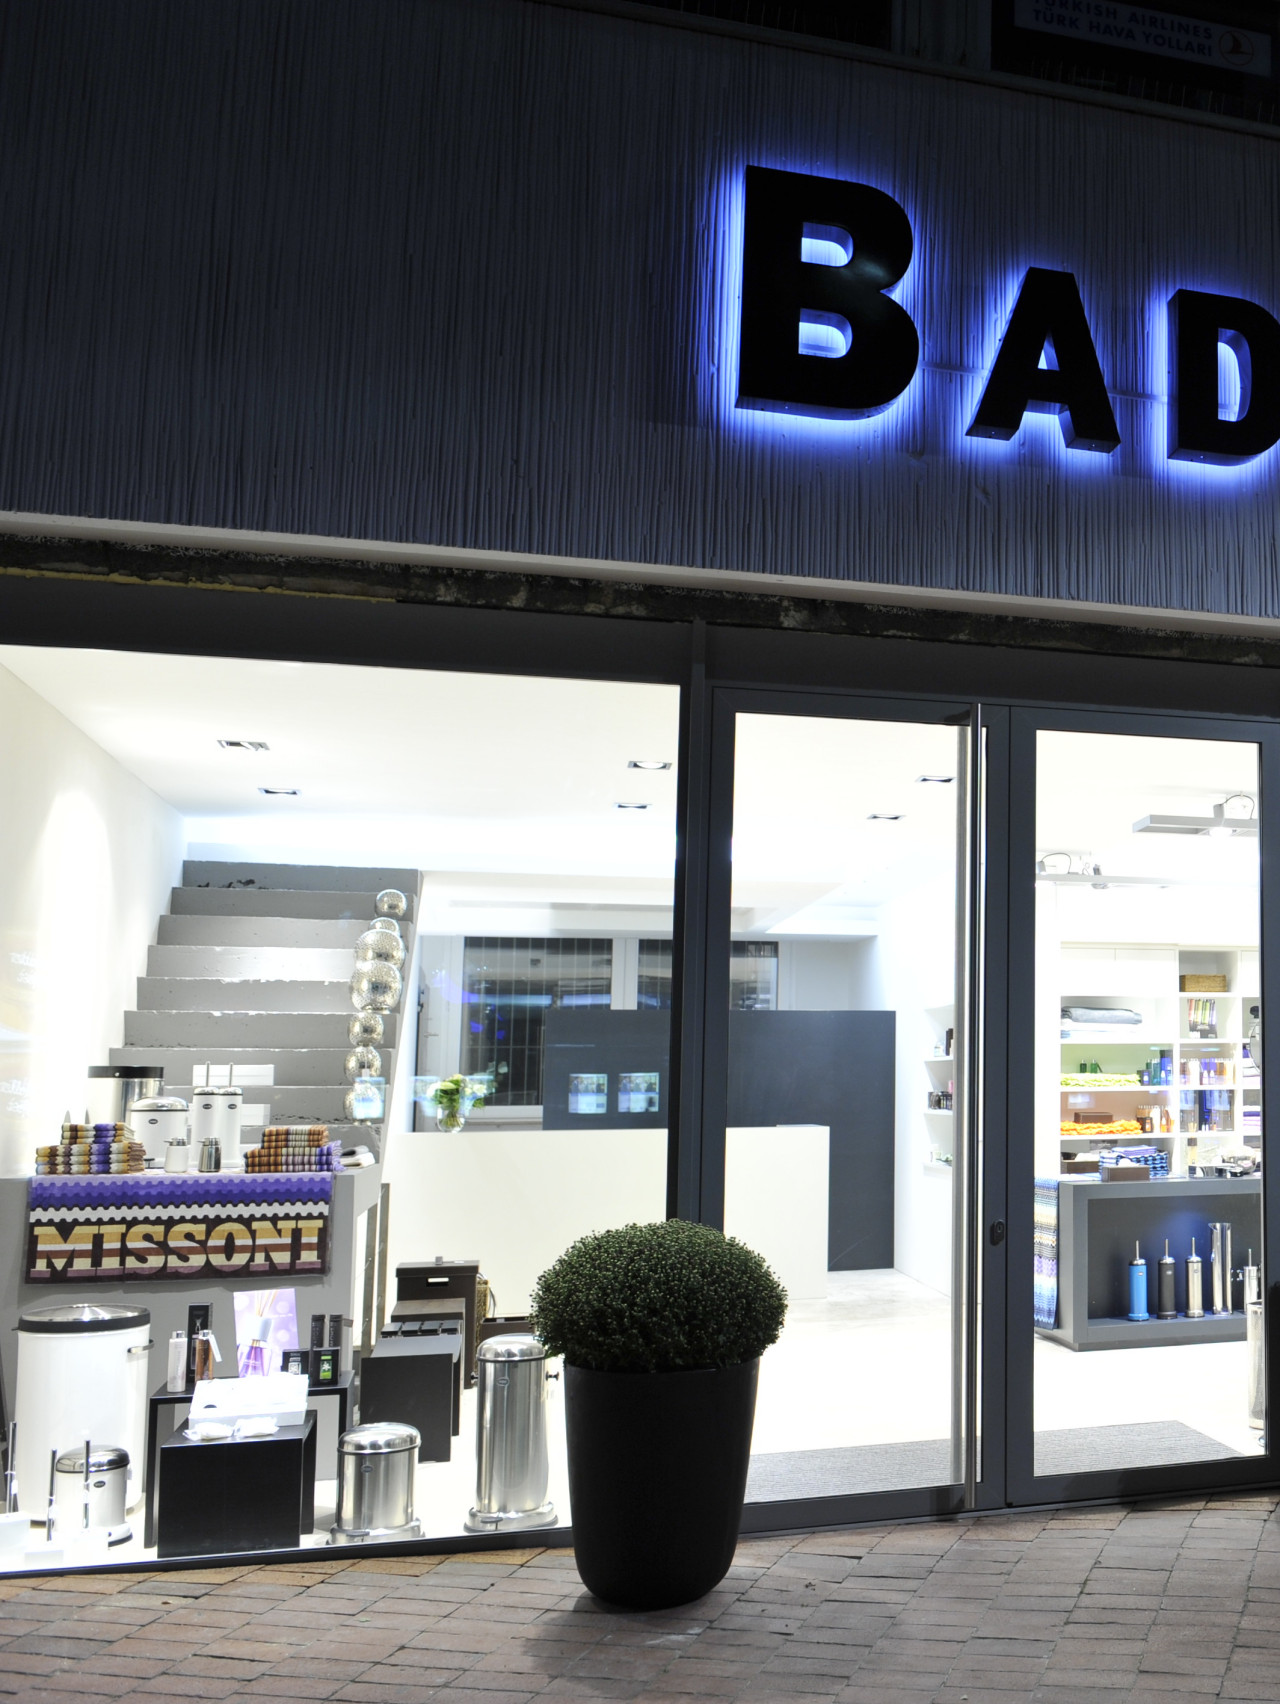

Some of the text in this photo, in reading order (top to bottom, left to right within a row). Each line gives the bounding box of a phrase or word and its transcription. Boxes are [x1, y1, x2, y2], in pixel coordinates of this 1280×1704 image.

[1032, 7, 1212, 57] TÜRK HAVA YOLLARI
[1127, 11, 1212, 40] AIRLINES
[30, 1219, 324, 1277] MISSONI
